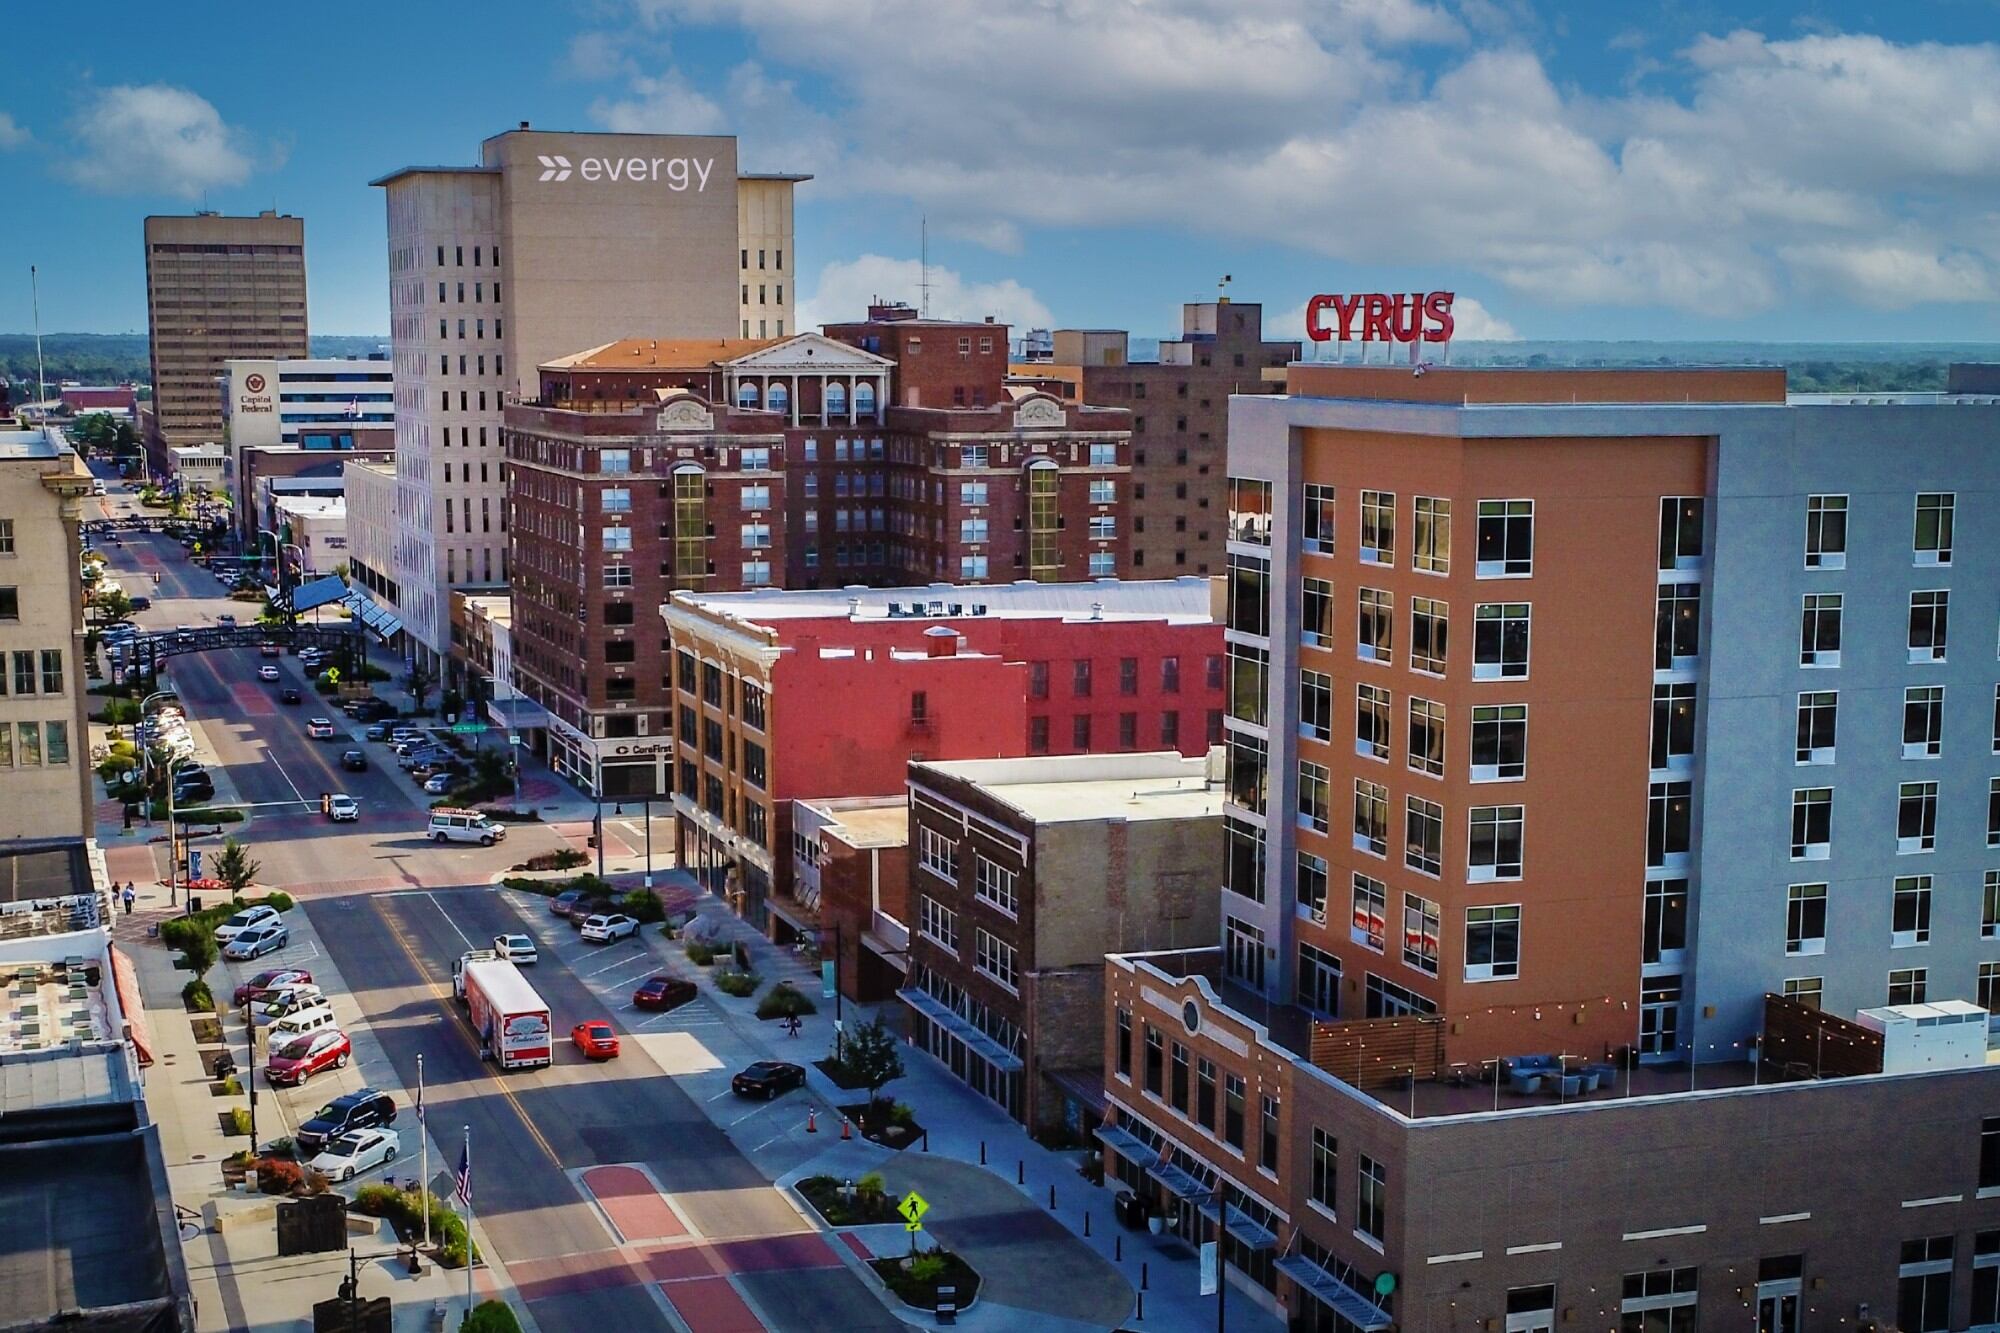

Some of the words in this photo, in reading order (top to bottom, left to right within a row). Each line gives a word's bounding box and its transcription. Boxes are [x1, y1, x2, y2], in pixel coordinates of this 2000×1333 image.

[581, 158, 714, 192] evergy
[1306, 291, 1455, 342] CYRUS
[241, 395, 271, 404] Capitol
[241, 405, 272, 413] Federal
